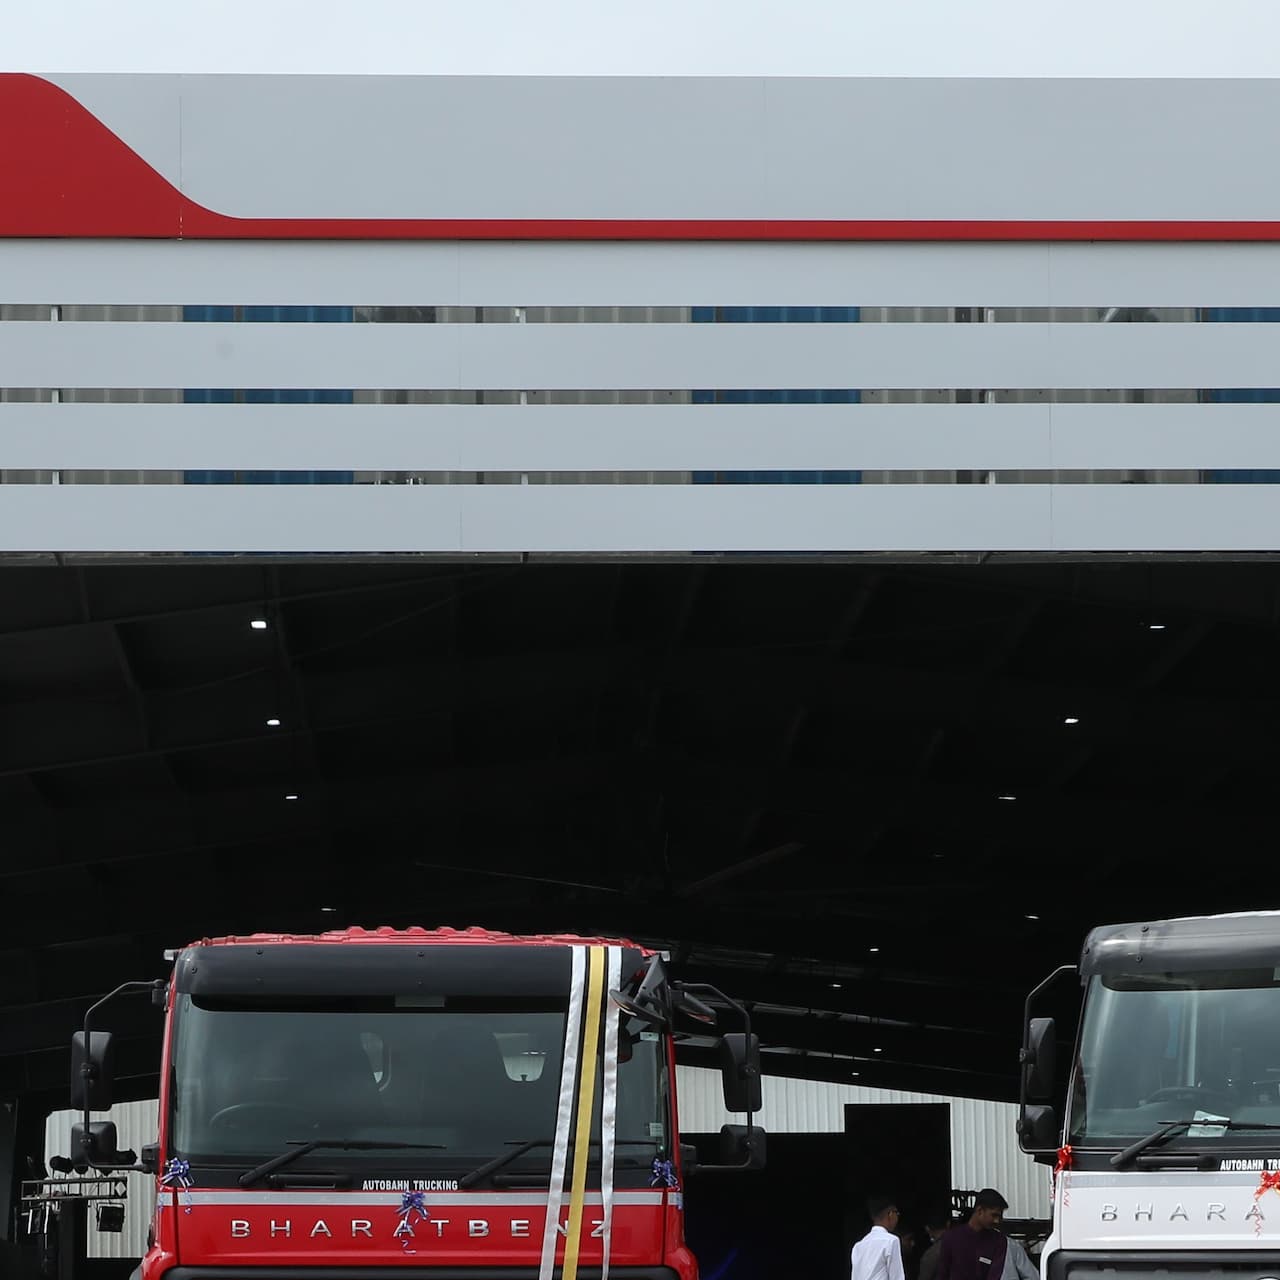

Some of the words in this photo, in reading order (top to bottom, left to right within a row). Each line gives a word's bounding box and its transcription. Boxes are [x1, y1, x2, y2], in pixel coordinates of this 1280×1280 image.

[1220, 1160, 1265, 1171] AUTOBAHN
[362, 1180, 410, 1191] AUTOBAHN
[413, 1180, 459, 1191] TRUCKING
